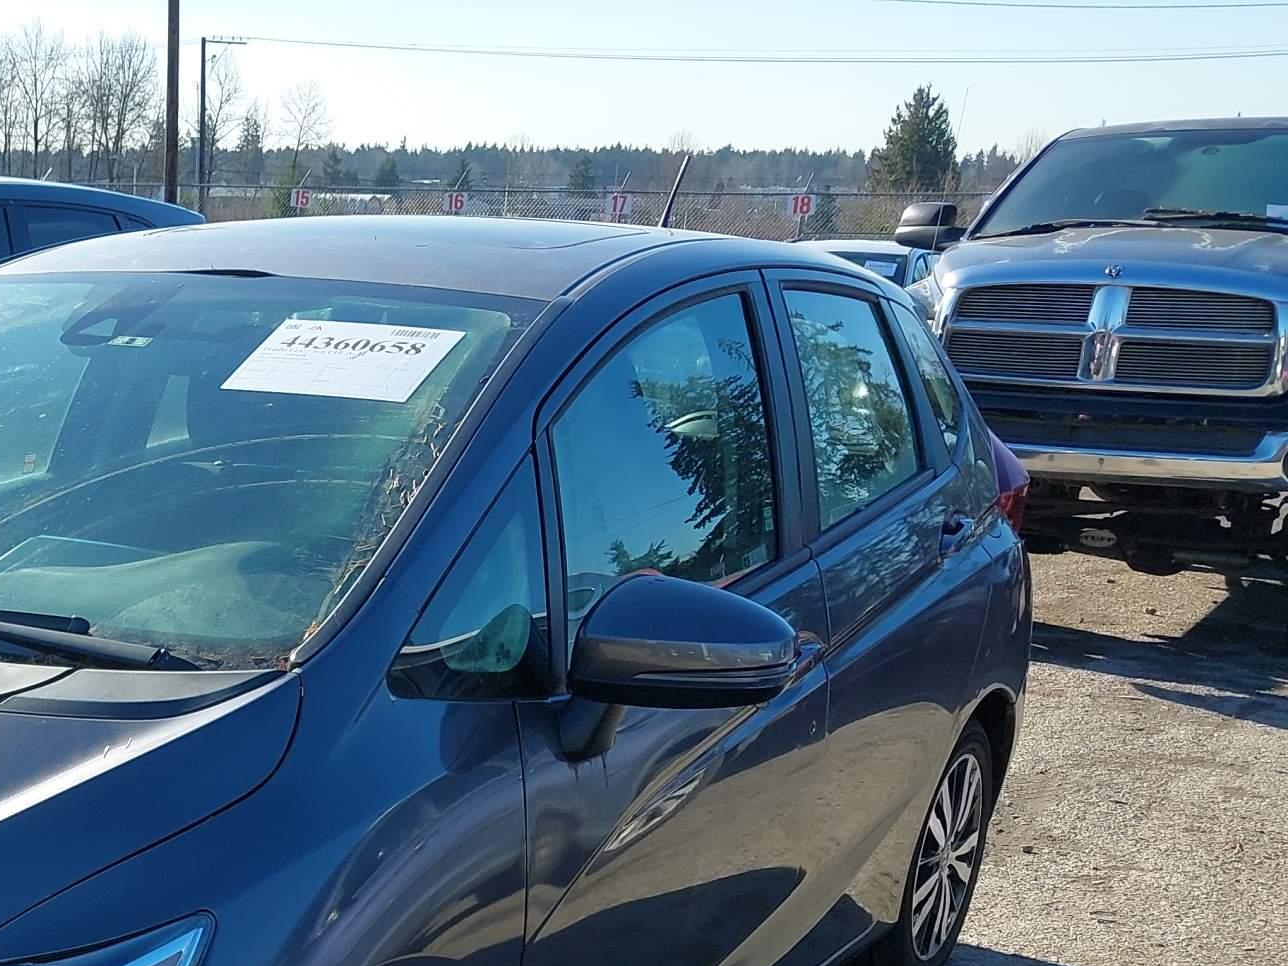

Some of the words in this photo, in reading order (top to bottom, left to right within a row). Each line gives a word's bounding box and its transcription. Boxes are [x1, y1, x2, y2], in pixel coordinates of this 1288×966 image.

[295, 190, 309, 206] 15
[447, 193, 464, 210] 16
[612, 195, 628, 212] 17
[792, 195, 812, 214] 18
[280, 335, 426, 356] 44360658
